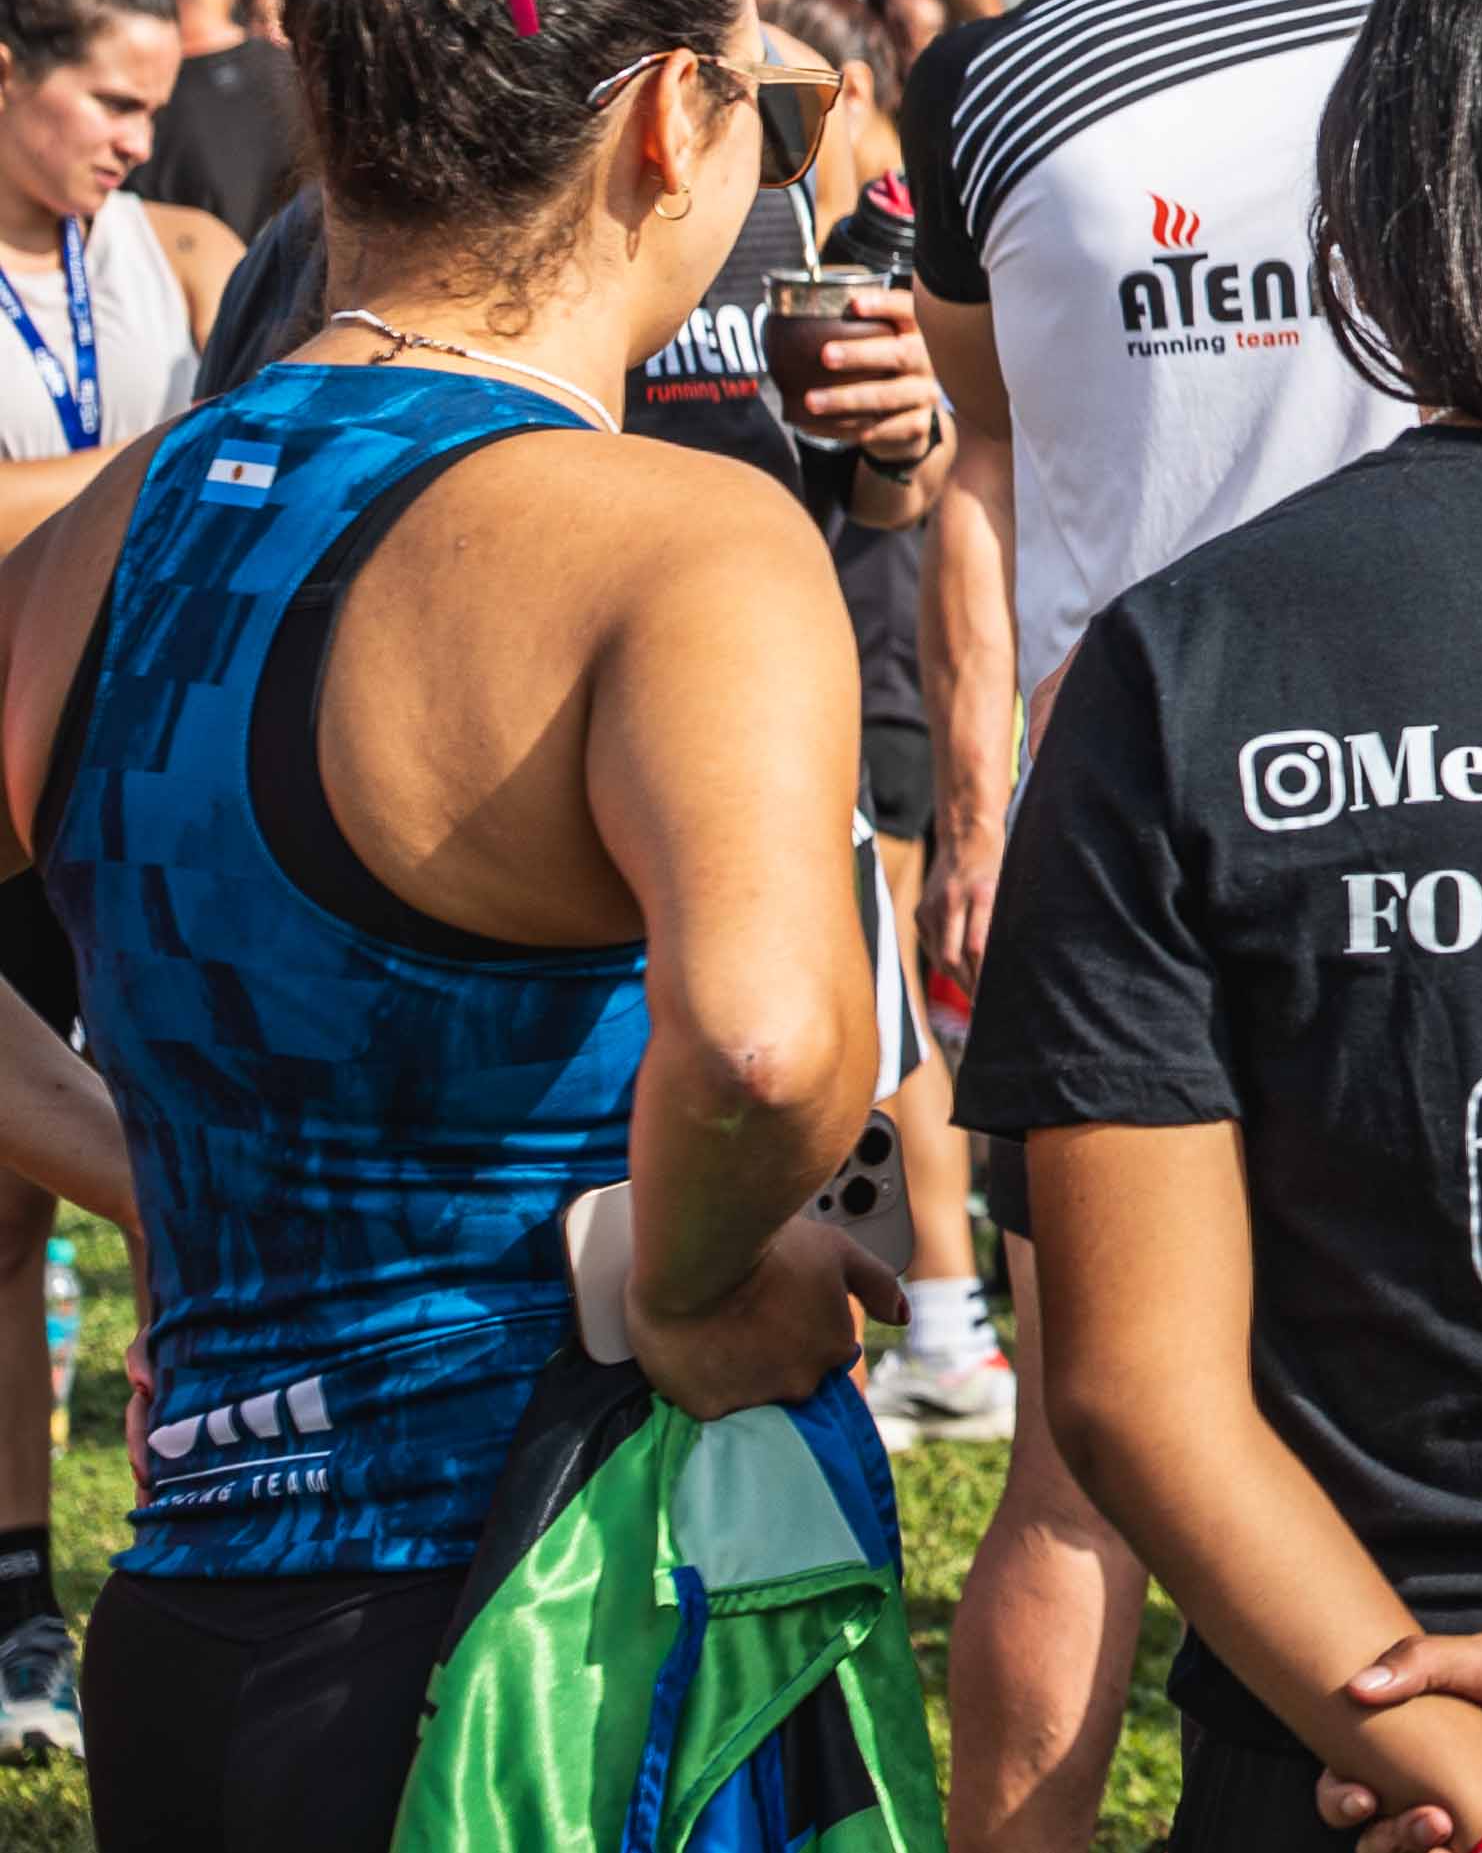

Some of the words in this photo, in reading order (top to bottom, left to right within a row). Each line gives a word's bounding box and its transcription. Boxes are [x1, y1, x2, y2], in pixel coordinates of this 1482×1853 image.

[1127, 335, 1226, 358] running
[1236, 329, 1300, 349] team
[252, 1468, 329, 1499] TEAM
